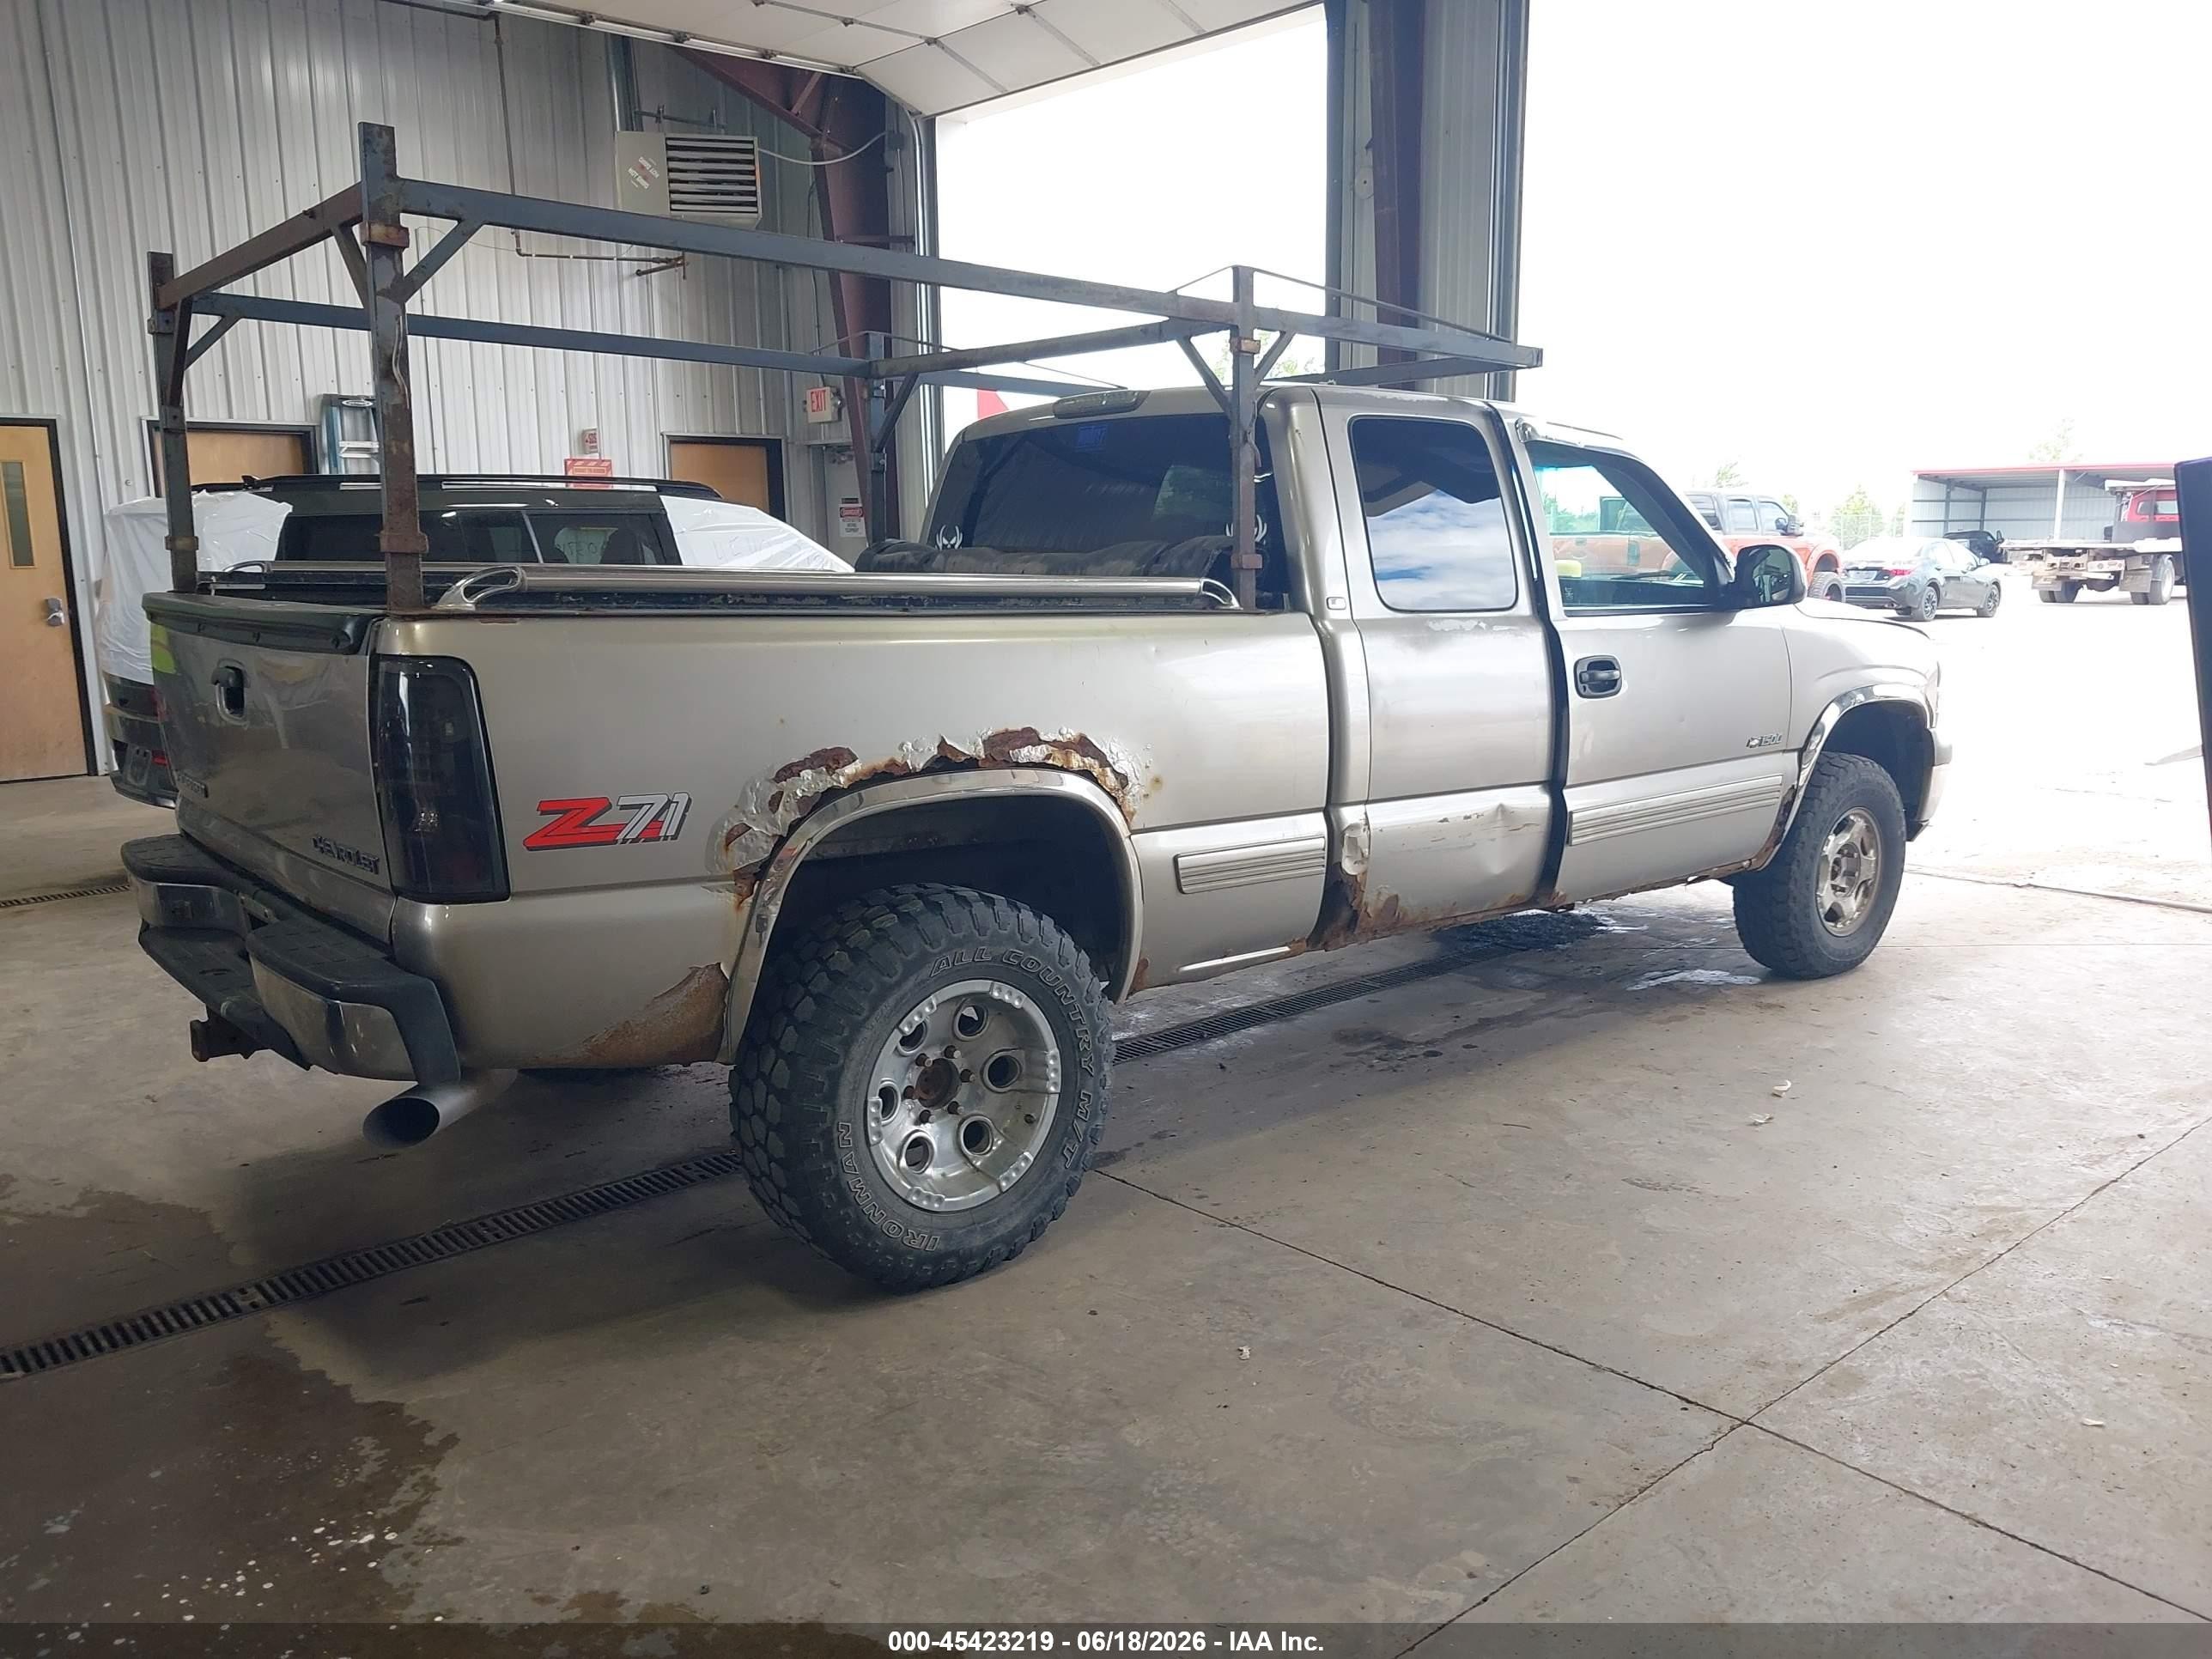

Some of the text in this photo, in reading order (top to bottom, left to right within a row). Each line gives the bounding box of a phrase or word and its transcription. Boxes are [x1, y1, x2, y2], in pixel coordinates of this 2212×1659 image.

[810, 389, 826, 413] EXIT
[523, 792, 693, 852] Z71
[312, 836, 380, 875] CHEVROLET
[930, 946, 1095, 1169] ALL COUNTRY M/T
[836, 1121, 941, 1252] IRONMAN
